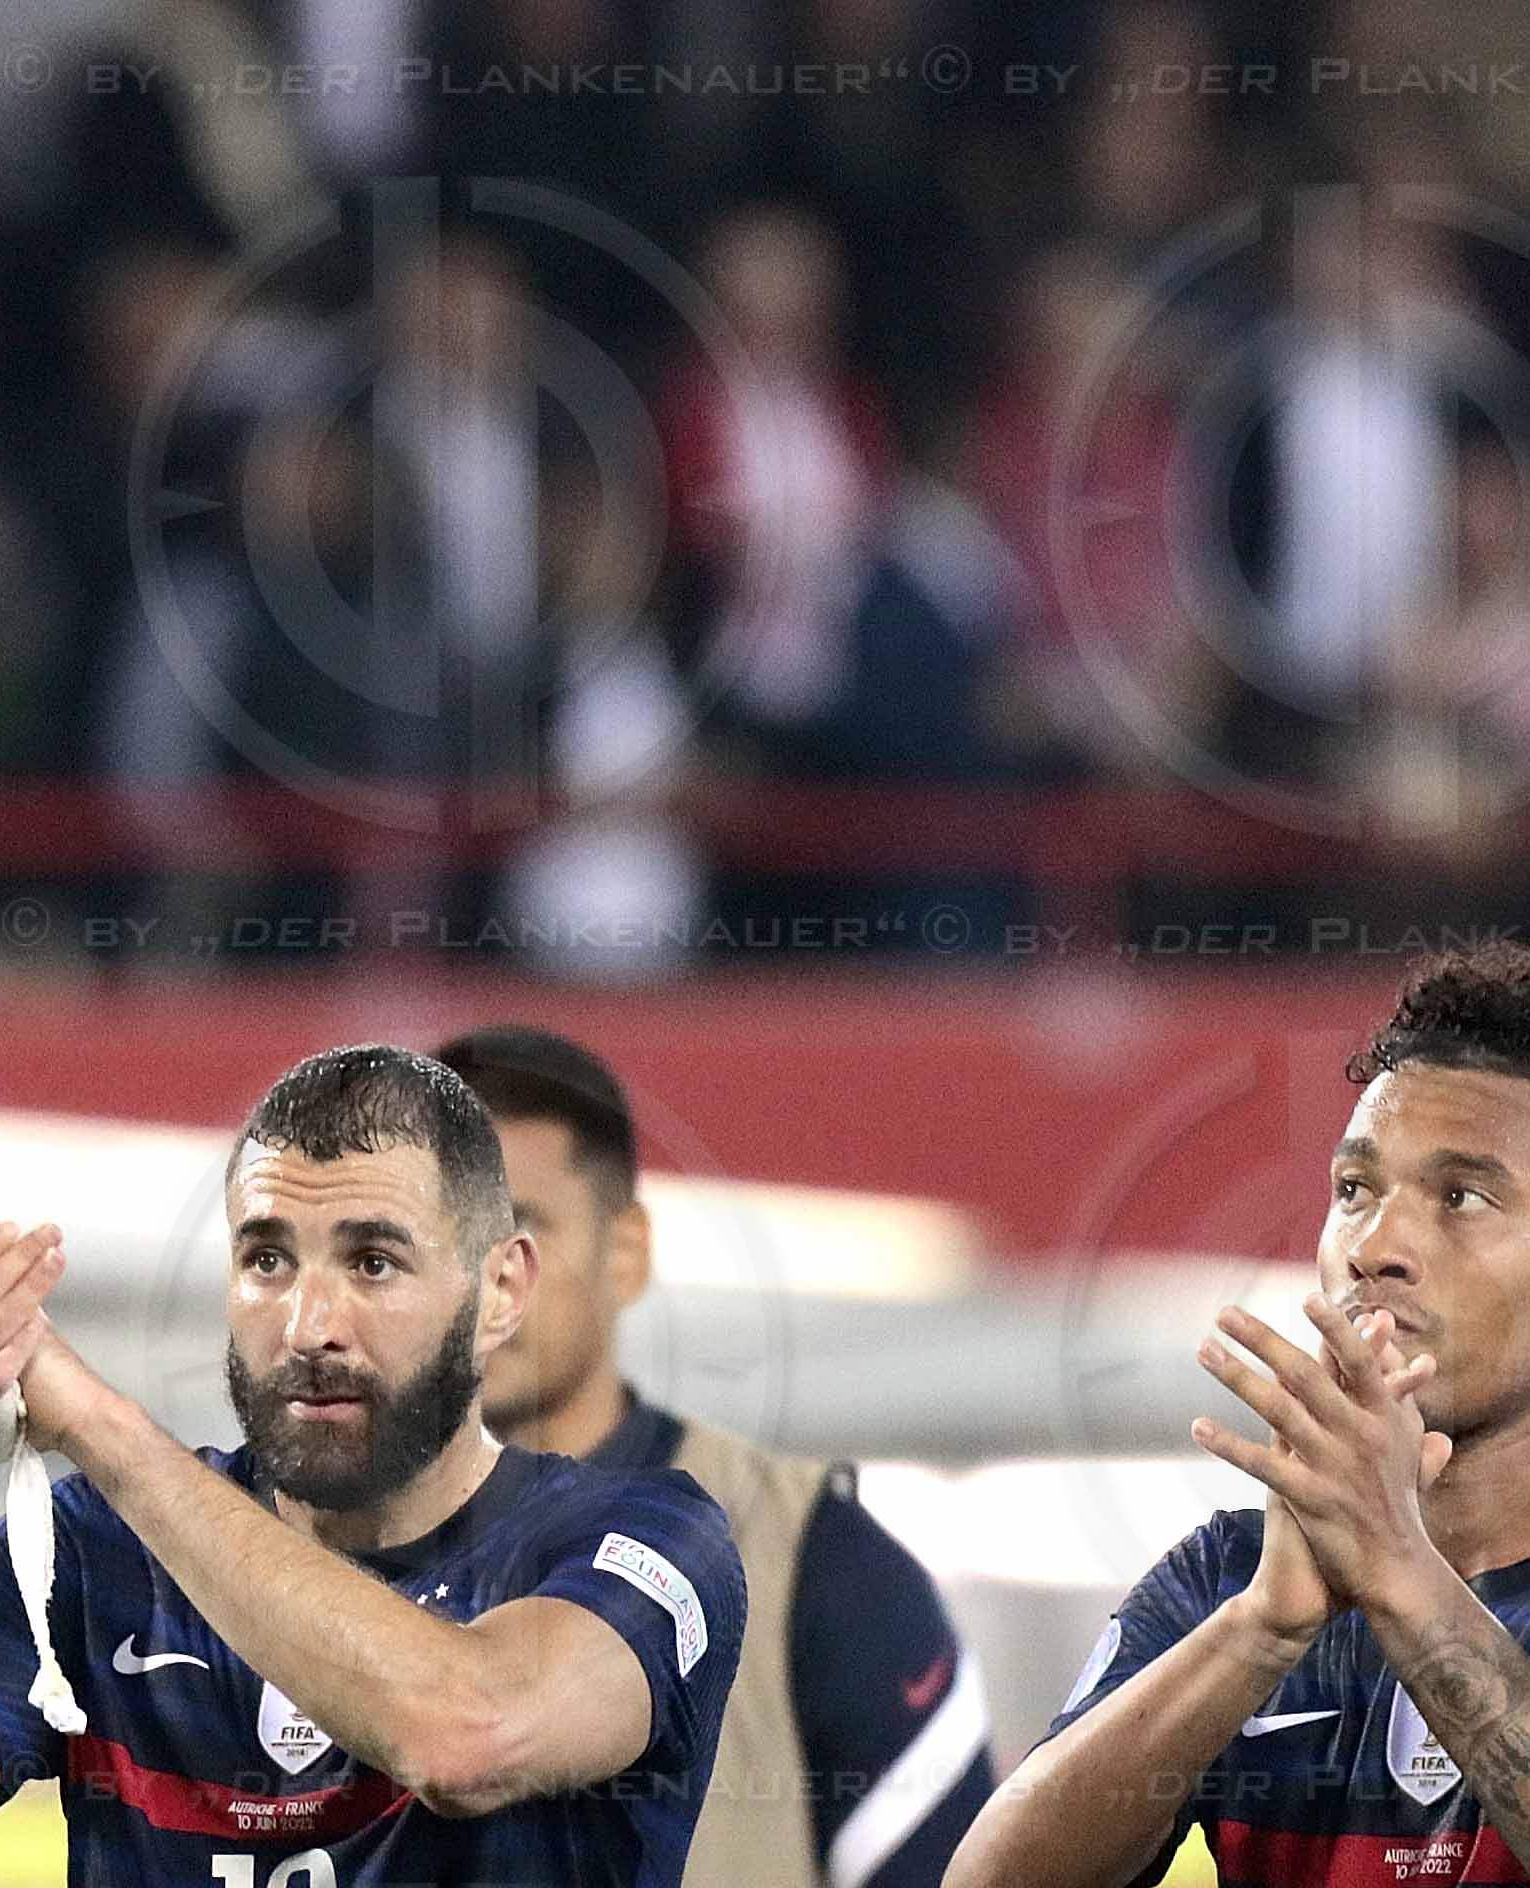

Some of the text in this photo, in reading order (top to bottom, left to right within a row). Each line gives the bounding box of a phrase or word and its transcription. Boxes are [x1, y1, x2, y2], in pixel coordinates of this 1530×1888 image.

[281, 1727, 315, 1740] FIFA
[1411, 1757, 1447, 1770] FIFA
[237, 1815, 252, 1830] 10
